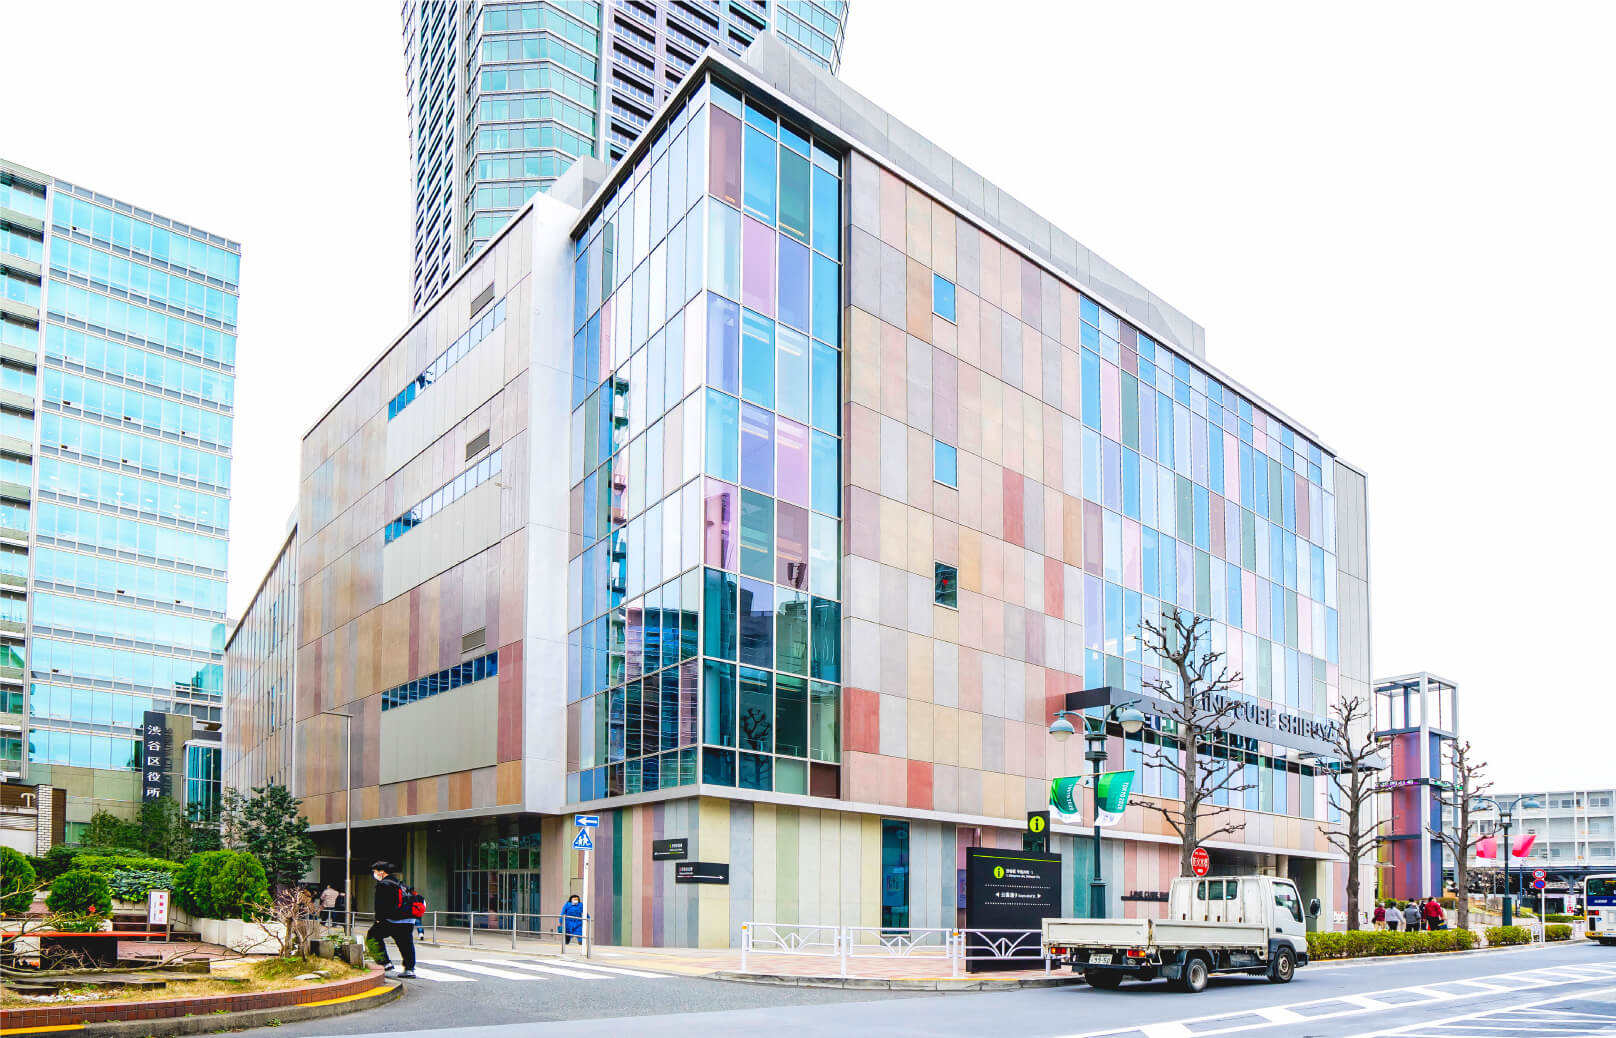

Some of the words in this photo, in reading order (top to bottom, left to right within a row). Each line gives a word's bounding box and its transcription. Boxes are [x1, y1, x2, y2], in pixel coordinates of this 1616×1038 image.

[1234, 701, 1277, 728] CUBE
[1279, 712, 1340, 742] SHIBUYA
[147, 724, 161, 798] 渋谷区役所
